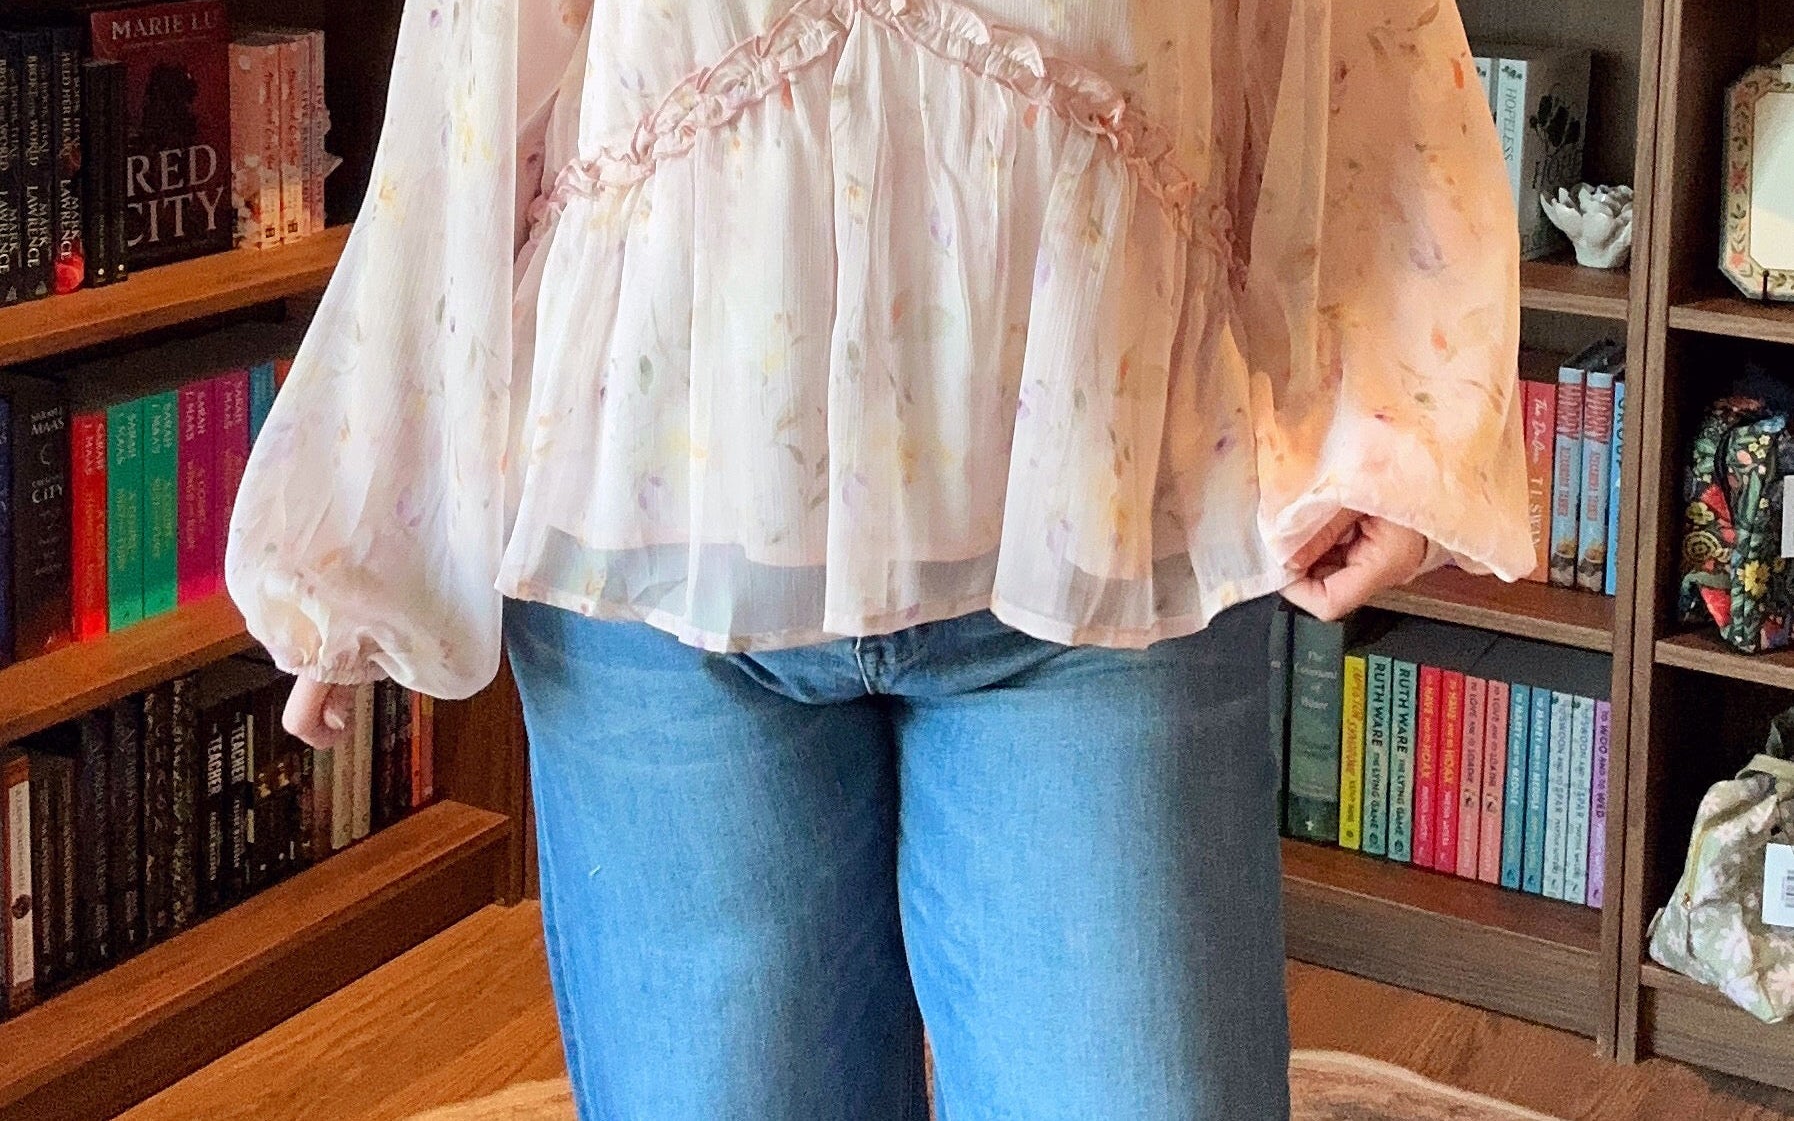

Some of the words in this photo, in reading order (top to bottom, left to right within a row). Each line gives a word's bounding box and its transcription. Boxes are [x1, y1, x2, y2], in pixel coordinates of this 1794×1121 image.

[112, 14, 184, 40] MARIE
[191, 10, 218, 29] LU
[26, 120, 39, 166] WORLD
[1504, 87, 1518, 161] HOPELESS
[127, 144, 217, 198] RED
[27, 186, 39, 267] LAWRENCE
[60, 180, 71, 260] LAWRENCE
[1530, 477, 1543, 487] T
[1373, 663, 1386, 703] RUTH
[1398, 668, 1410, 710] RUTH
[1371, 707, 1384, 747] WARE
[1396, 713, 1410, 753] WARE
[1579, 722, 1589, 758] SWOON
[208, 735, 222, 797] TEACHER
[231, 724, 245, 785] TEACHER
[1421, 744, 1433, 778] HOAX
[1443, 750, 1455, 784] HOAX
[1371, 768, 1381, 798] LYING
[1396, 775, 1407, 804] LYING
[1554, 787, 1564, 813] SPAR
[1395, 807, 1405, 836] GAME
[1576, 792, 1586, 818] SPAR
